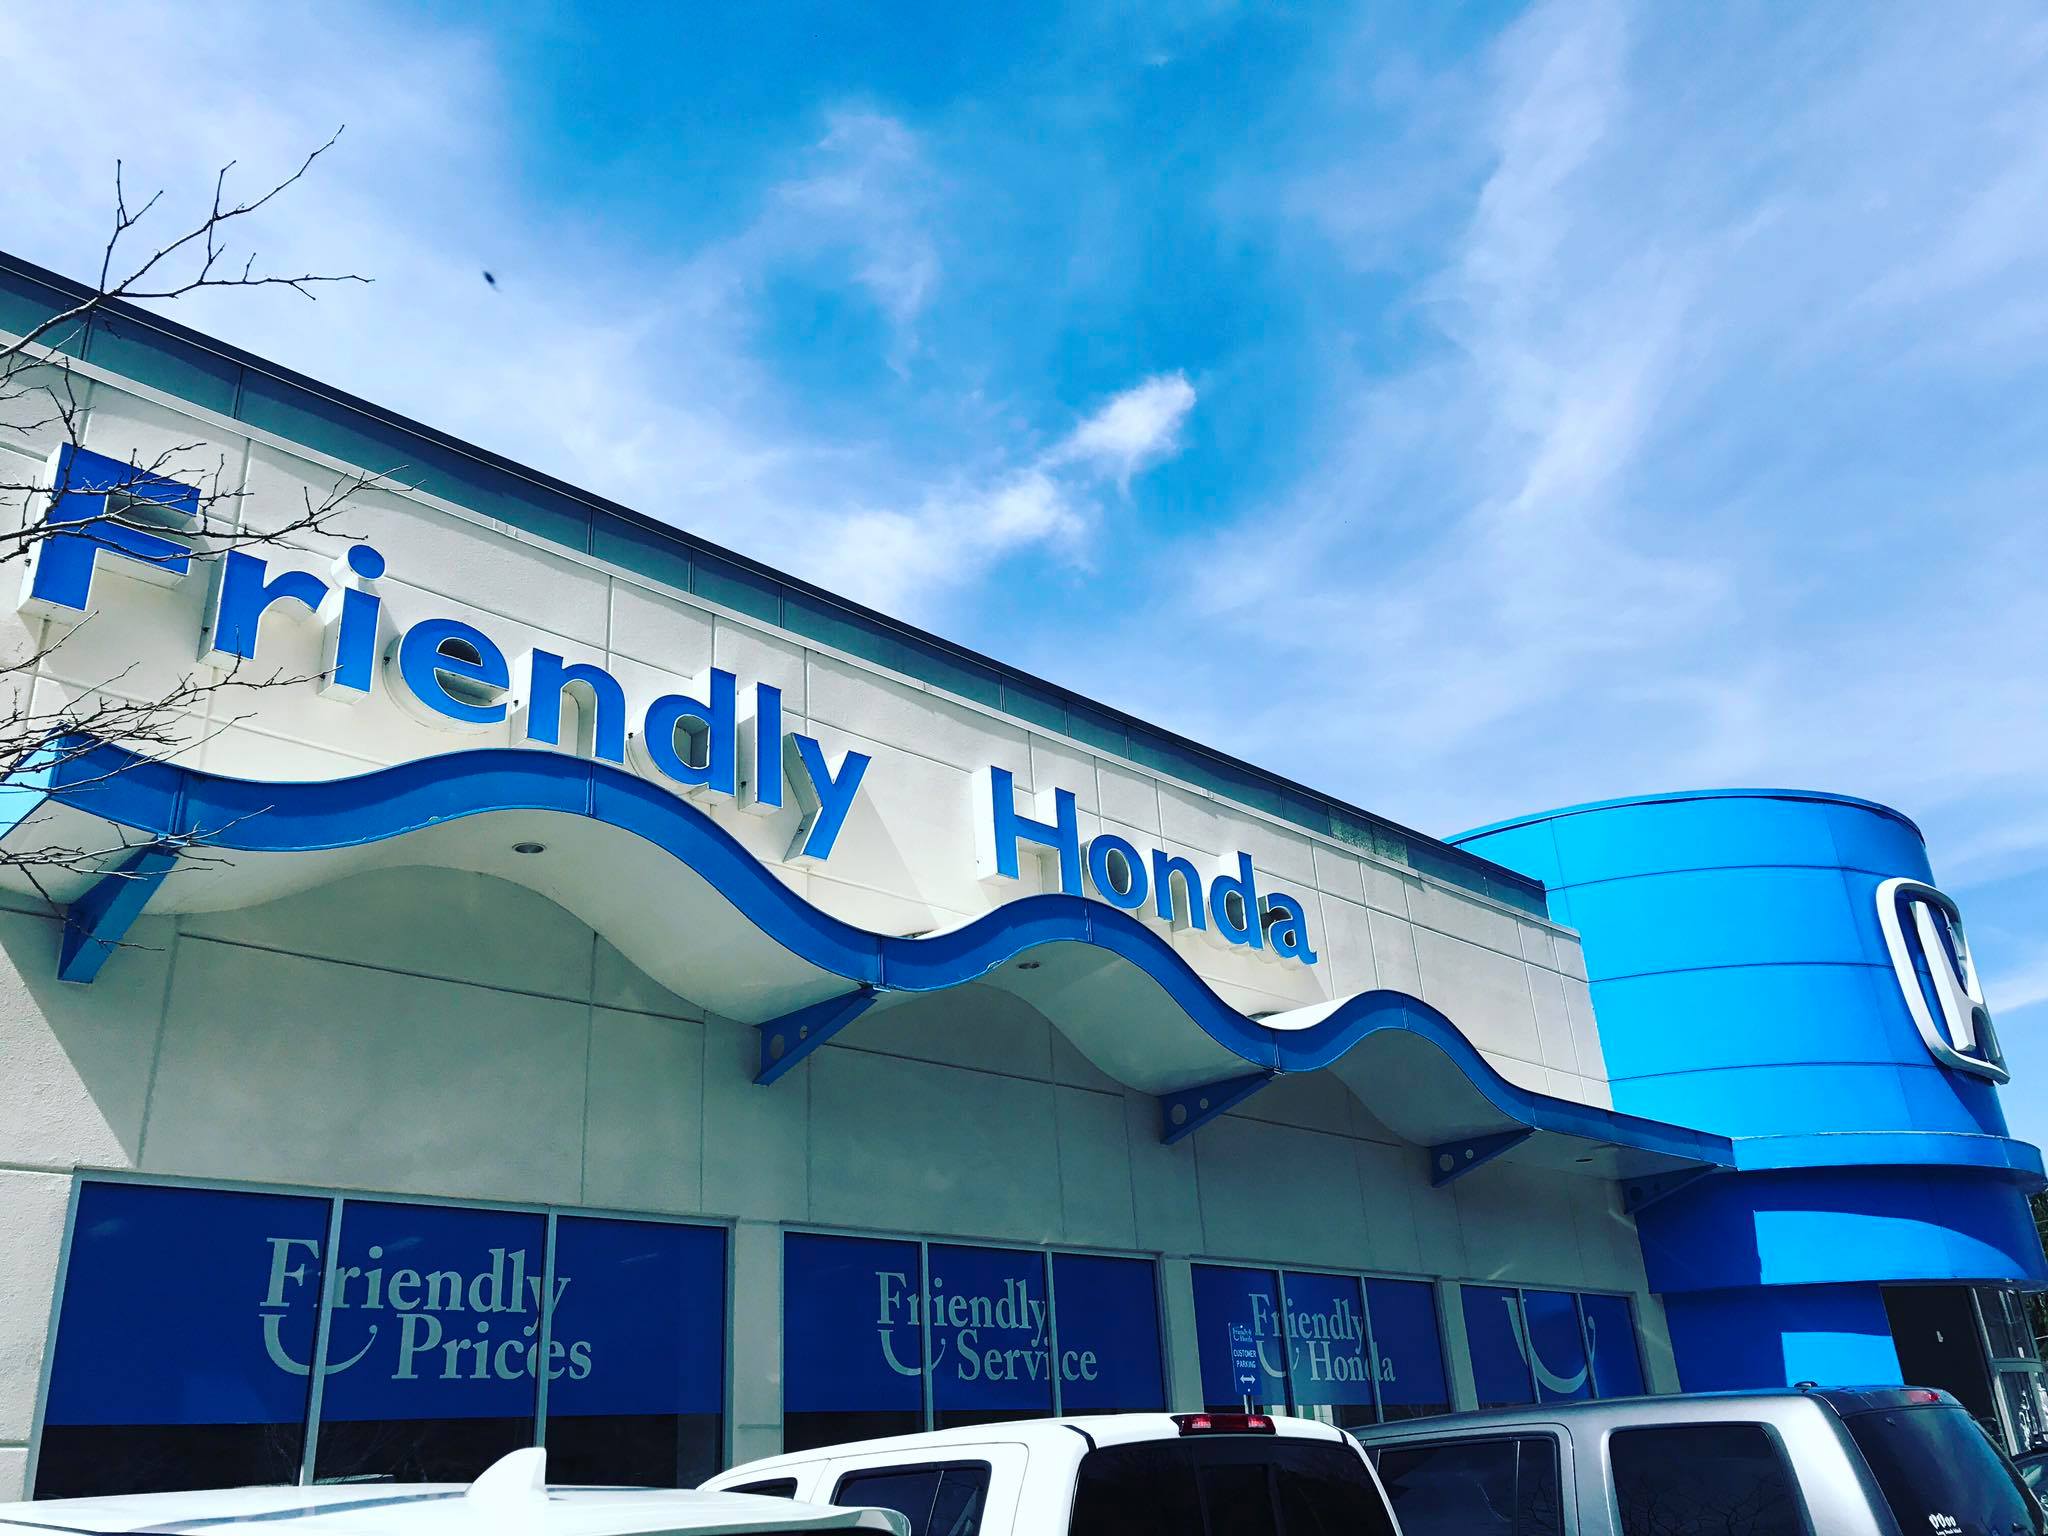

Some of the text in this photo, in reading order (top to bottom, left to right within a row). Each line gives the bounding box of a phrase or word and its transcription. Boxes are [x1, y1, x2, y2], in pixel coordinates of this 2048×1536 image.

[24, 440, 1319, 966] Friendly Honda
[259, 1236, 572, 1337] Friendly
[875, 1270, 1046, 1348] Friendly
[1248, 1293, 1364, 1354] Friendly
[391, 1312, 592, 1380] Prices
